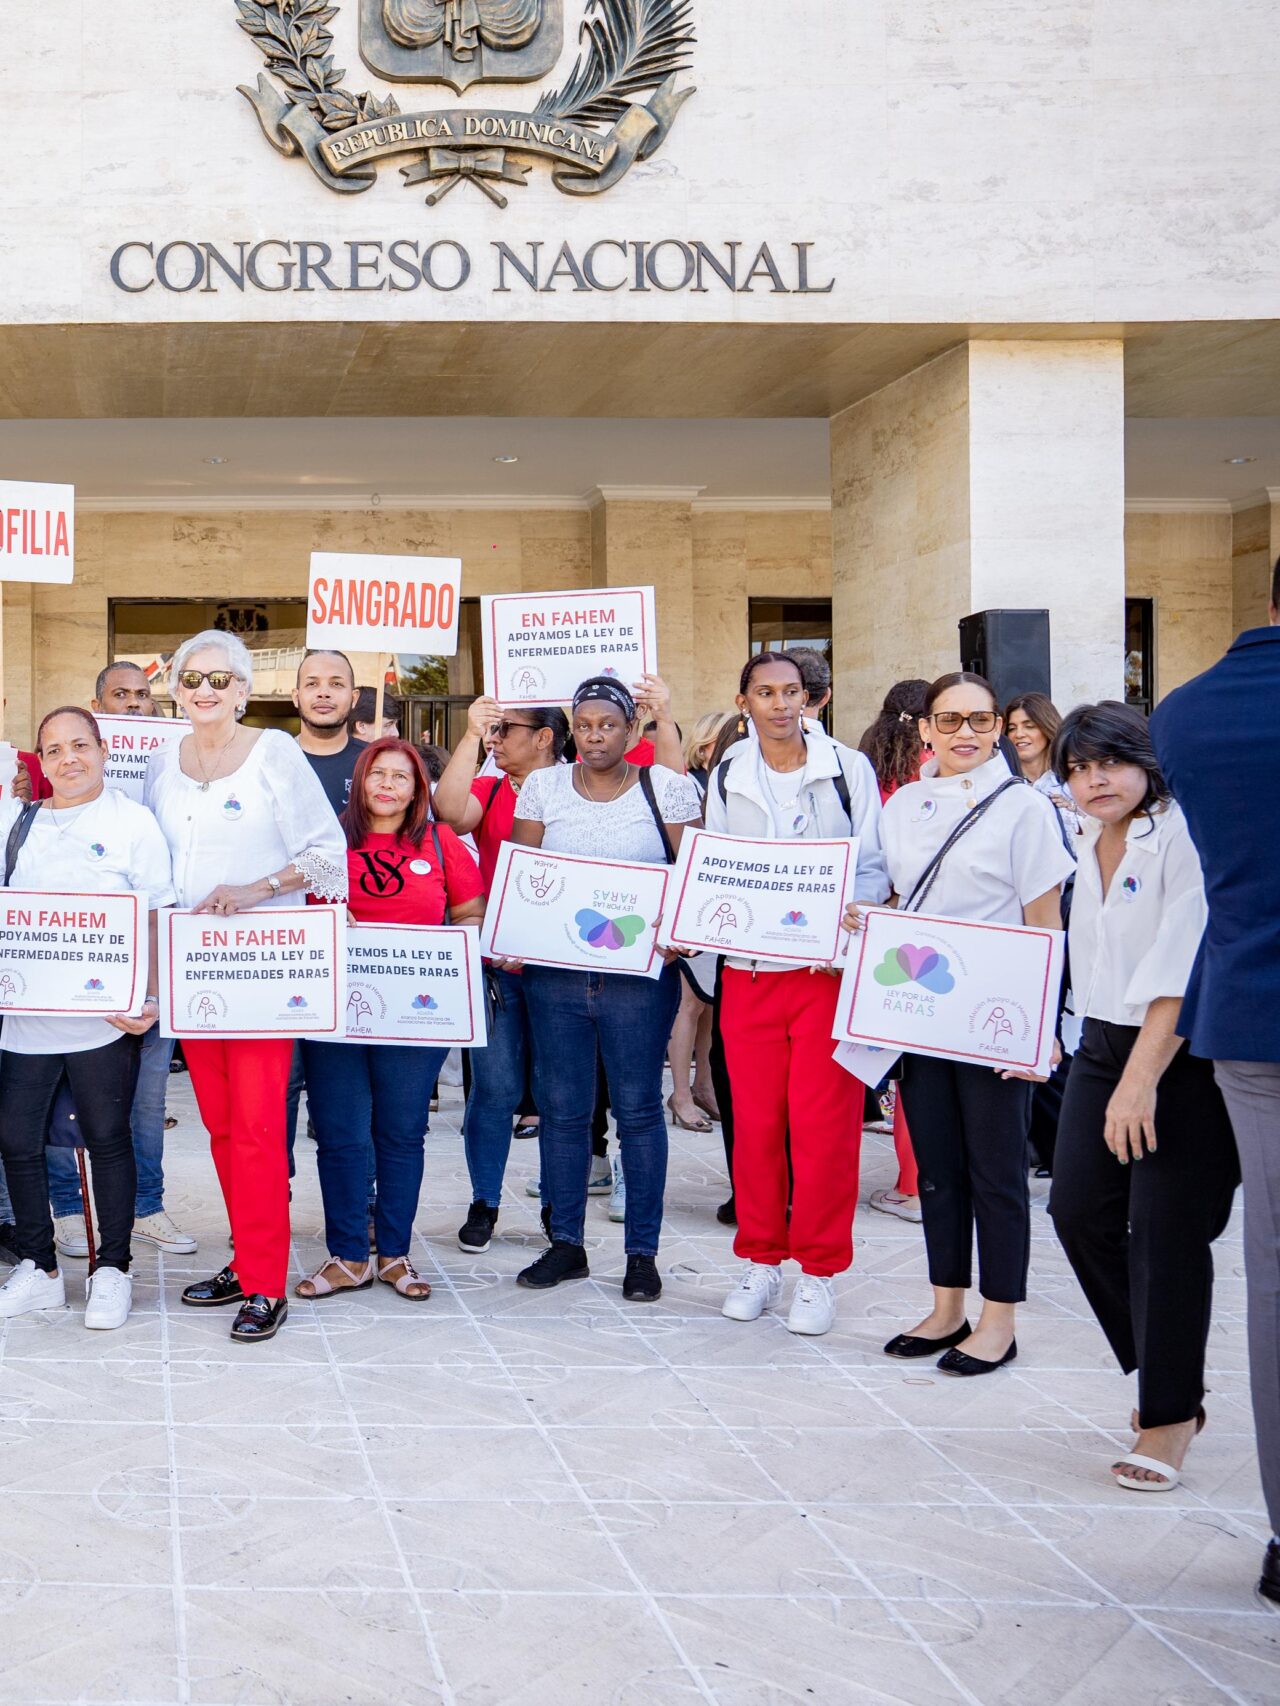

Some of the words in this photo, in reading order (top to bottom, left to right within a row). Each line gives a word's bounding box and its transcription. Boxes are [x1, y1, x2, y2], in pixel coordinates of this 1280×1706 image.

[328, 117, 453, 162] REPUBLICA
[464, 116, 606, 165] DOMINICANA
[109, 239, 471, 293] CONGRESO
[492, 240, 835, 293] NACIONAL
[312, 578, 454, 629] SANGRADO
[522, 613, 545, 627] EN
[552, 609, 615, 625] FAHEM
[508, 630, 570, 641] APOYAMOS
[576, 629, 588, 638] LA
[594, 628, 614, 637] LEY
[620, 627, 633, 635] DE
[508, 645, 596, 657] ENFERMEDADES
[601, 643, 638, 652] RARAS
[112, 735, 134, 749] EN
[534, 860, 558, 870] FAHEM
[703, 857, 770, 873] APOYEMOS
[774, 865, 788, 874] LA
[794, 865, 815, 875] LEY
[819, 866, 834, 875] DE
[697, 872, 793, 892] ENFERMEDADES
[797, 883, 835, 893] RARAS
[593, 890, 637, 904] RARAS
[606, 903, 621, 911] POR
[7, 910, 32, 925] EN
[39, 910, 106, 928] FAHEM
[63, 933, 76, 943] LA
[83, 934, 104, 944] LEY
[110, 935, 125, 944] DE
[202, 930, 227, 946] EN
[236, 929, 305, 945] FAHEM
[705, 935, 732, 945] FAHEM
[88, 952, 129, 963] RARAS
[186, 952, 256, 962] APOYAMOS
[261, 951, 276, 961] LA
[282, 950, 304, 960] LEY
[310, 950, 324, 960] DE
[393, 949, 406, 958] LA
[412, 950, 432, 960] LEY
[438, 951, 452, 961] DE
[186, 969, 284, 980] ENFERMEDADES
[289, 968, 330, 979] RARAS
[420, 967, 459, 977] RARAS
[887, 989, 899, 997] LEY
[902, 991, 919, 1000] POR
[921, 993, 935, 1002] LAS
[883, 999, 936, 1017] RARAS
[346, 1026, 372, 1034] FAHEM
[979, 1043, 1008, 1054] FAHEM
